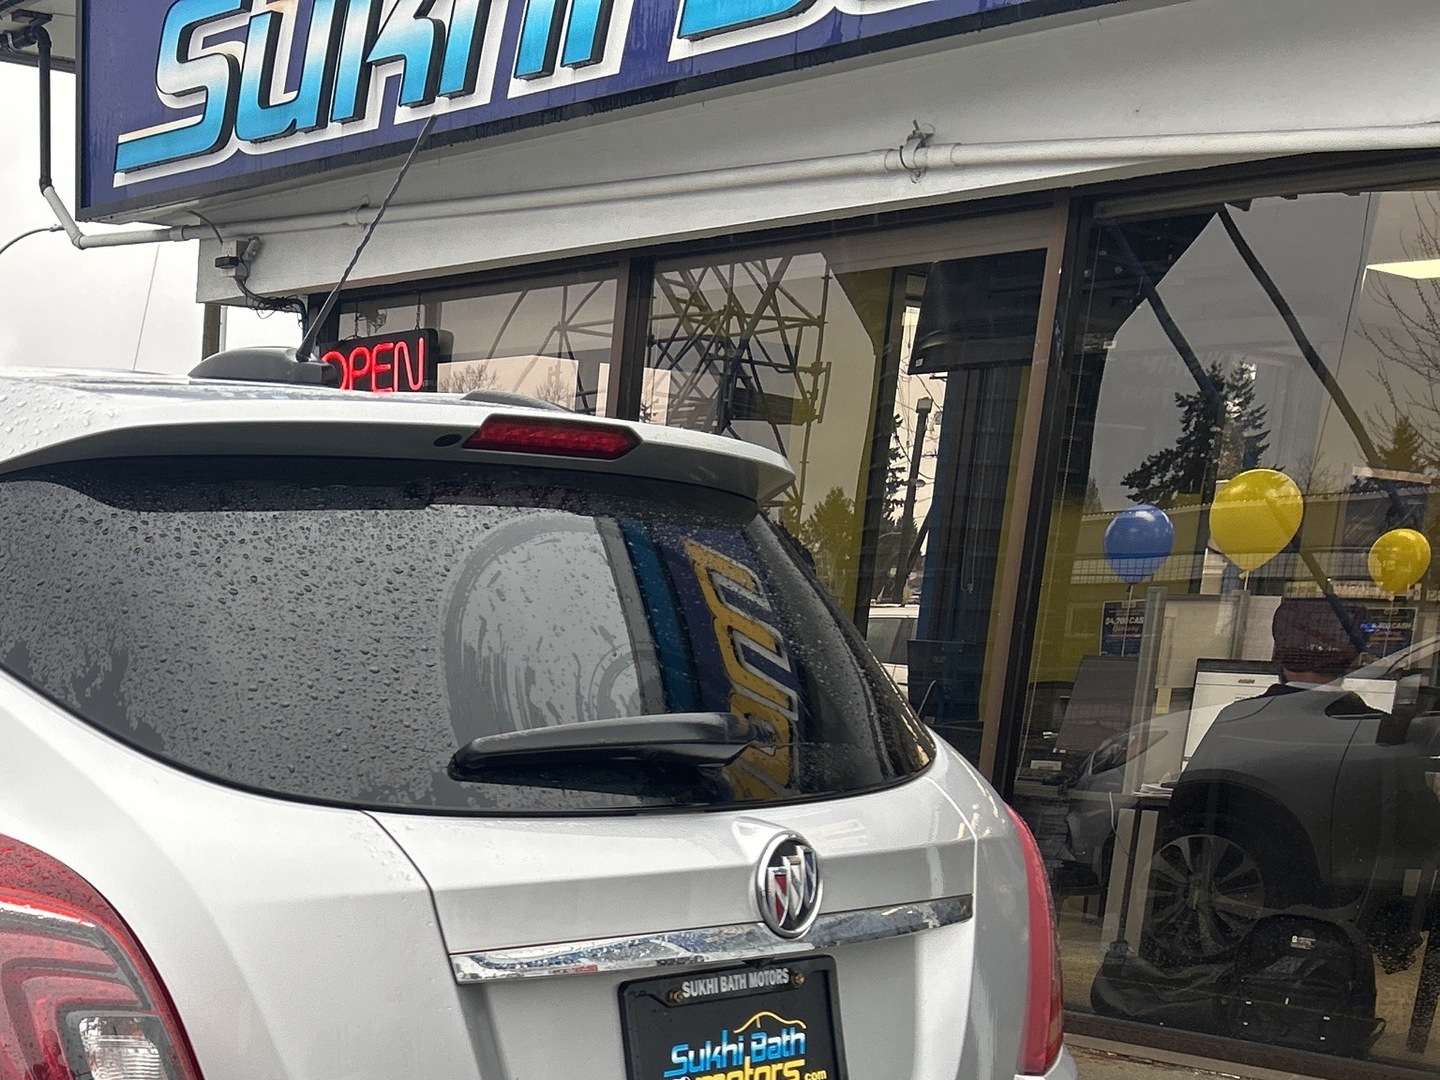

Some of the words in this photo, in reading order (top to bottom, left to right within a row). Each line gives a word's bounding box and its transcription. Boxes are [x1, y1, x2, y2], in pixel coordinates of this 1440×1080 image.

[321, 337, 425, 393] OPEN
[681, 977, 719, 998] SUKHI
[720, 973, 747, 993] BATH
[748, 967, 790, 988] MOTORS
[663, 1029, 745, 1078] Sukhi
[750, 1026, 807, 1063] Bath
